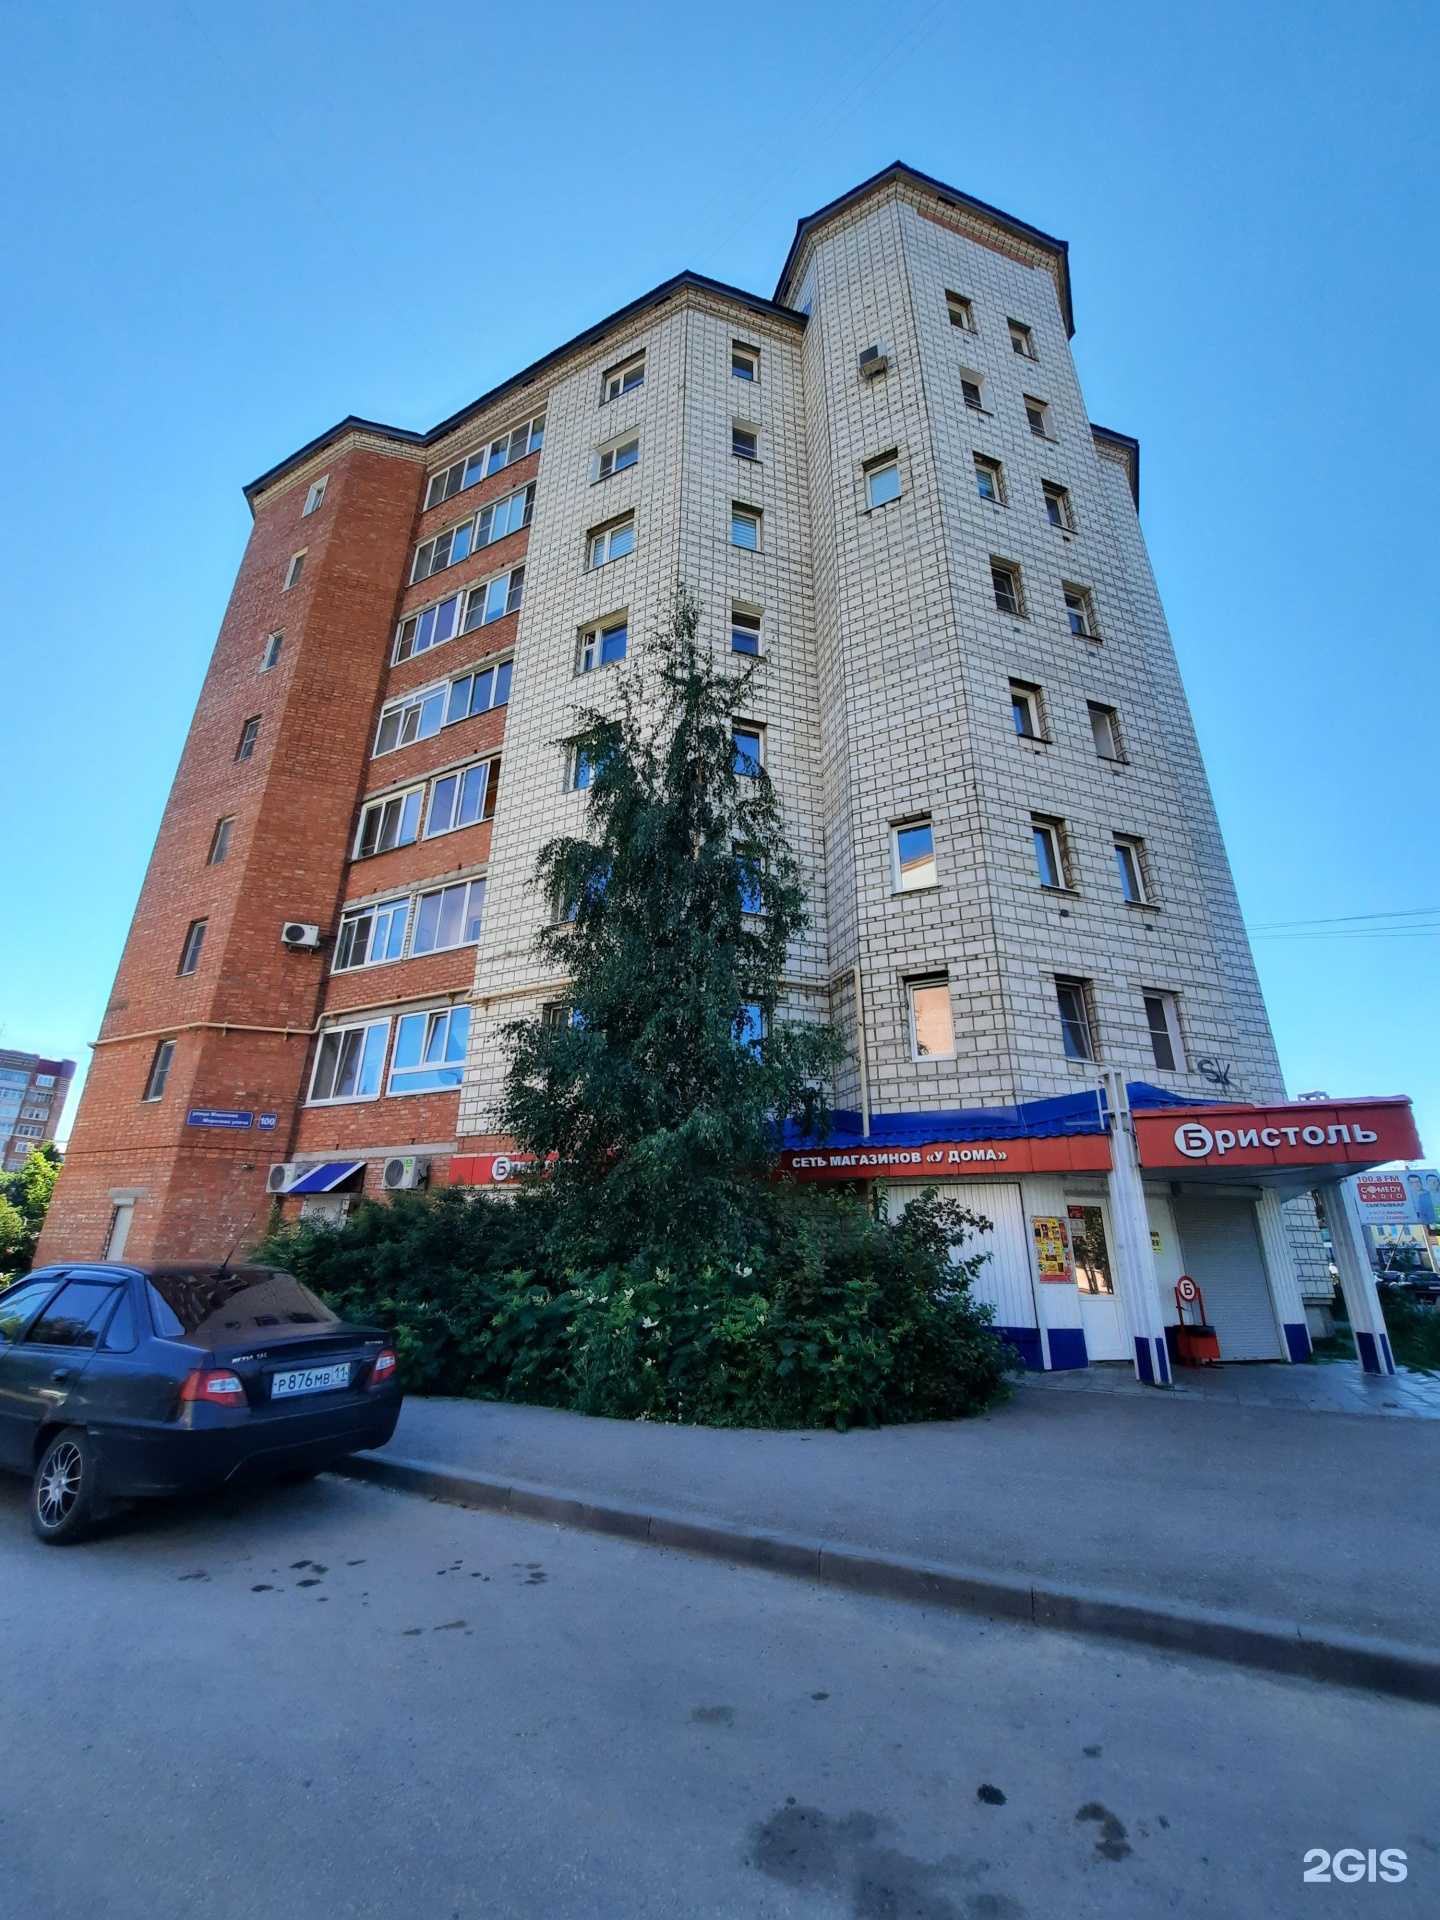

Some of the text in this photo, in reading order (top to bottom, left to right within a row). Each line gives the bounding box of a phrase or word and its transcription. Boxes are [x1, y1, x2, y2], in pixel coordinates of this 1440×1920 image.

[1174, 1123, 1378, 1158] Бристоль
[792, 1149, 1008, 1168] СЕТЬ МАГАЗИНОВ «У ДОМА»
[1360, 1185, 1401, 1194] COMEDY
